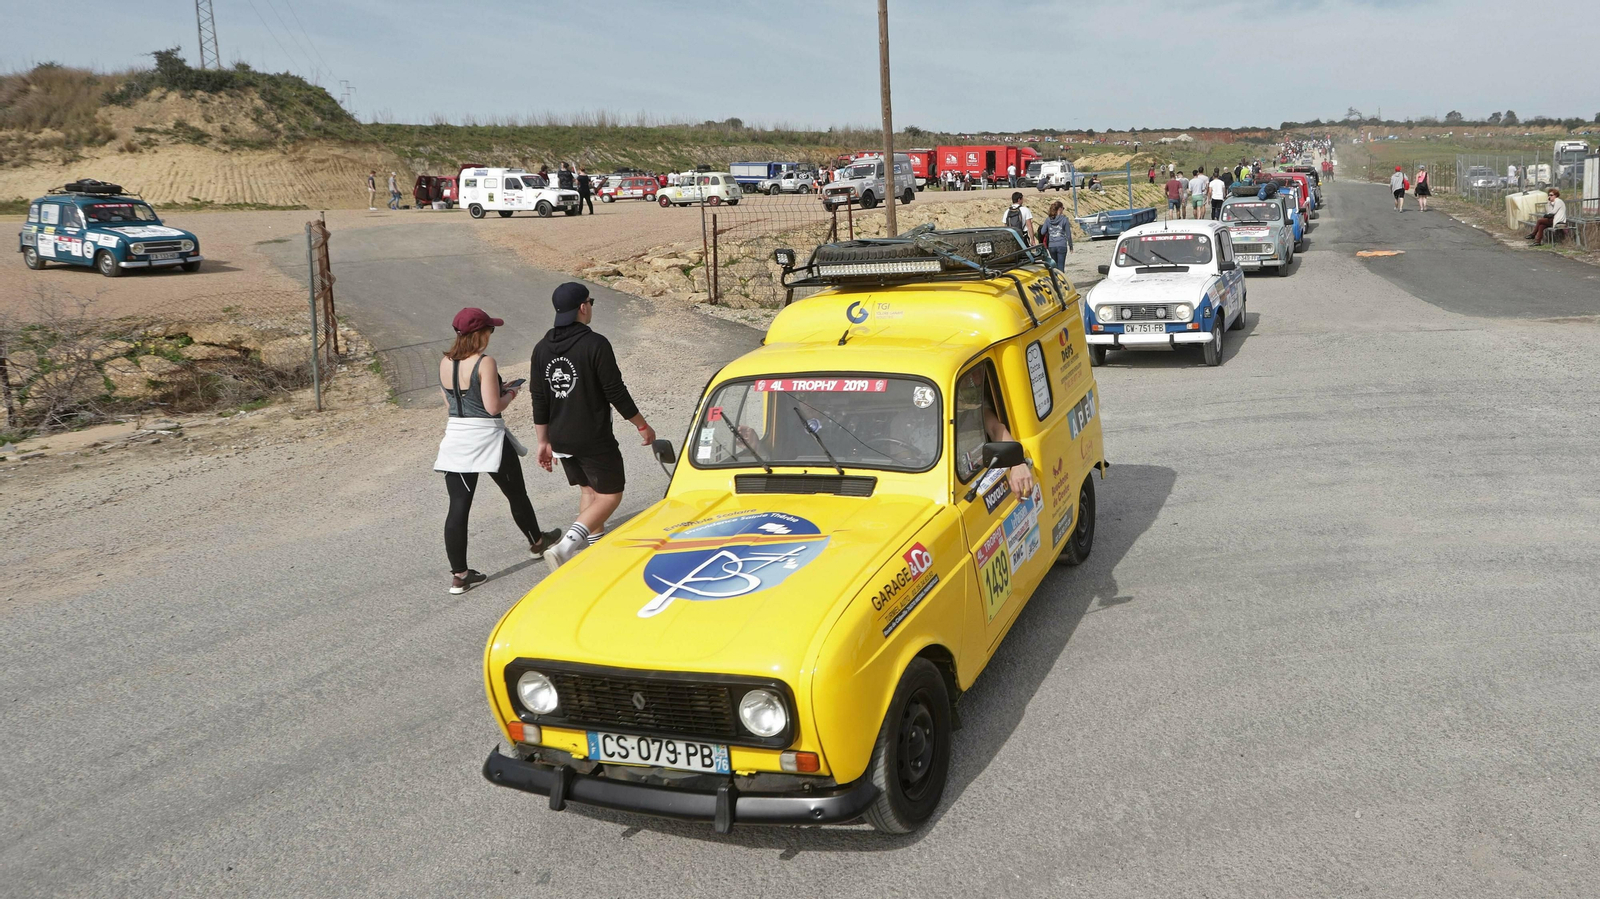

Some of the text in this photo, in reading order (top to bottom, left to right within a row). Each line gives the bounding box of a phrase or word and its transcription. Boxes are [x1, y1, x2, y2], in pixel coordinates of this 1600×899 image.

[877, 302, 890, 310] TGI
[1125, 323, 1164, 333] CW-751-FB
[770, 379, 869, 391] 4L TROPHY 2019
[710, 408, 720, 420] F
[1072, 397, 1096, 438] APEM
[985, 480, 1009, 509] Norauto
[716, 508, 757, 519] Scolaire
[684, 517, 738, 535] Providence
[977, 549, 984, 560] 4L
[1013, 544, 1023, 566] RMC
[986, 550, 1009, 605] 1439
[871, 567, 911, 611] GARAGE
[602, 734, 714, 768] CS-079-PB
[716, 757, 729, 771] 76
